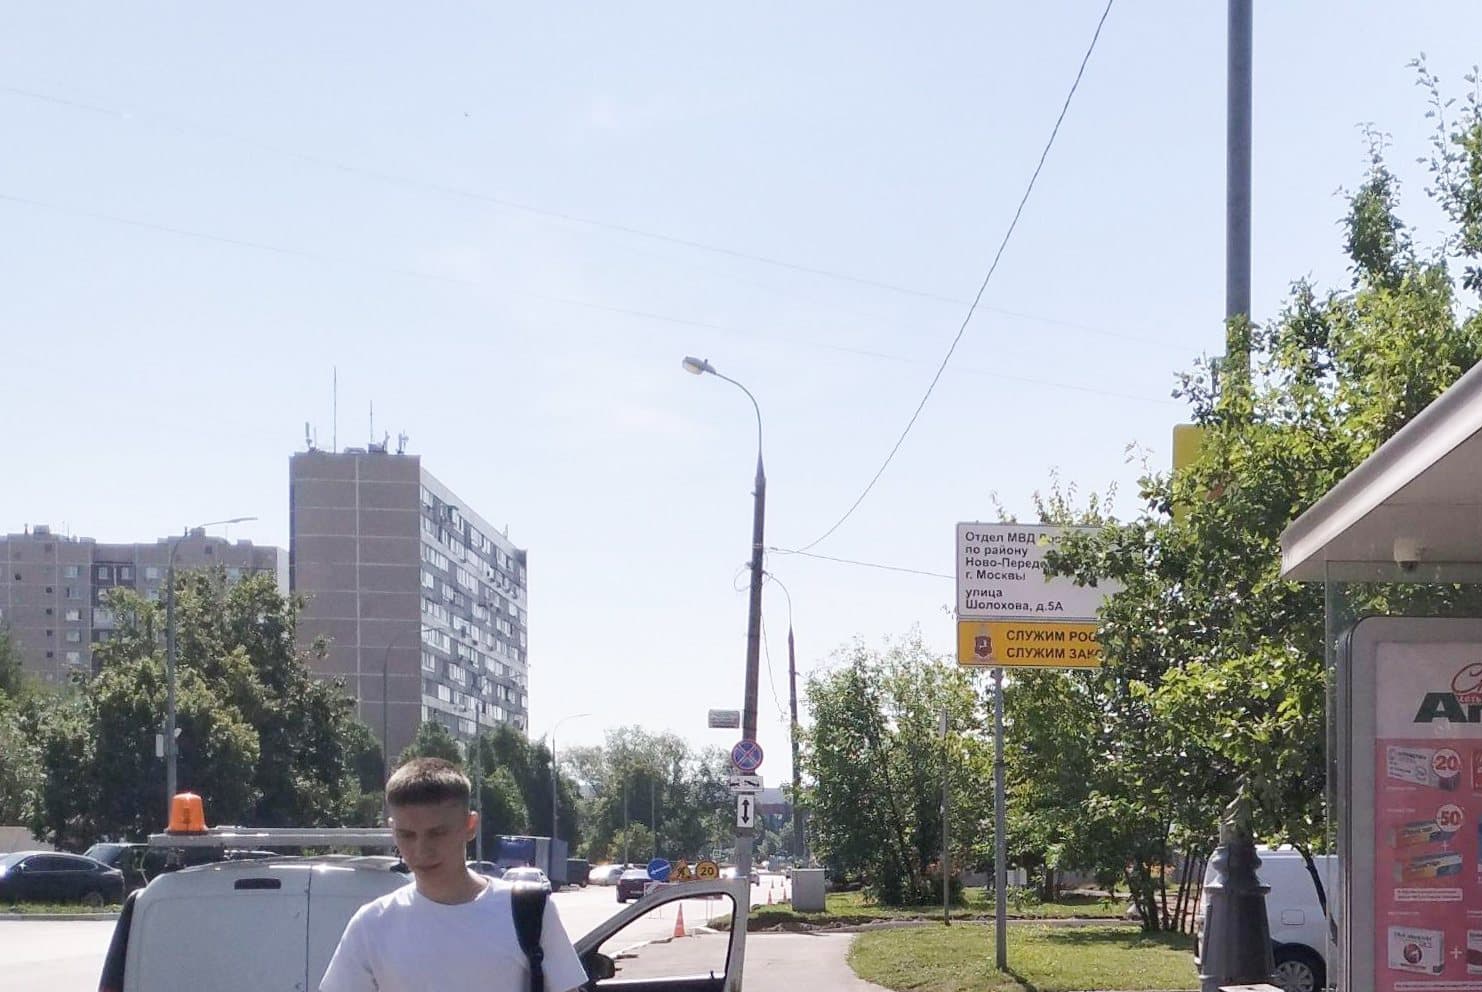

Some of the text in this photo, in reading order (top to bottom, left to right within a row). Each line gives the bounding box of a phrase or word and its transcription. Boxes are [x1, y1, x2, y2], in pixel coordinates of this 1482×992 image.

[965, 531, 1003, 543] Отдел
[1007, 532, 1036, 544] МВД
[965, 545, 1028, 557] по району
[965, 570, 1026, 580] г. Москвы
[965, 589, 1003, 598] улица
[965, 600, 1033, 612] Шолохова,
[1006, 630, 1096, 642] СЛУЖИМ РОС
[1006, 647, 1065, 658] СЛУЖИМ
[700, 867, 714, 876] 20
